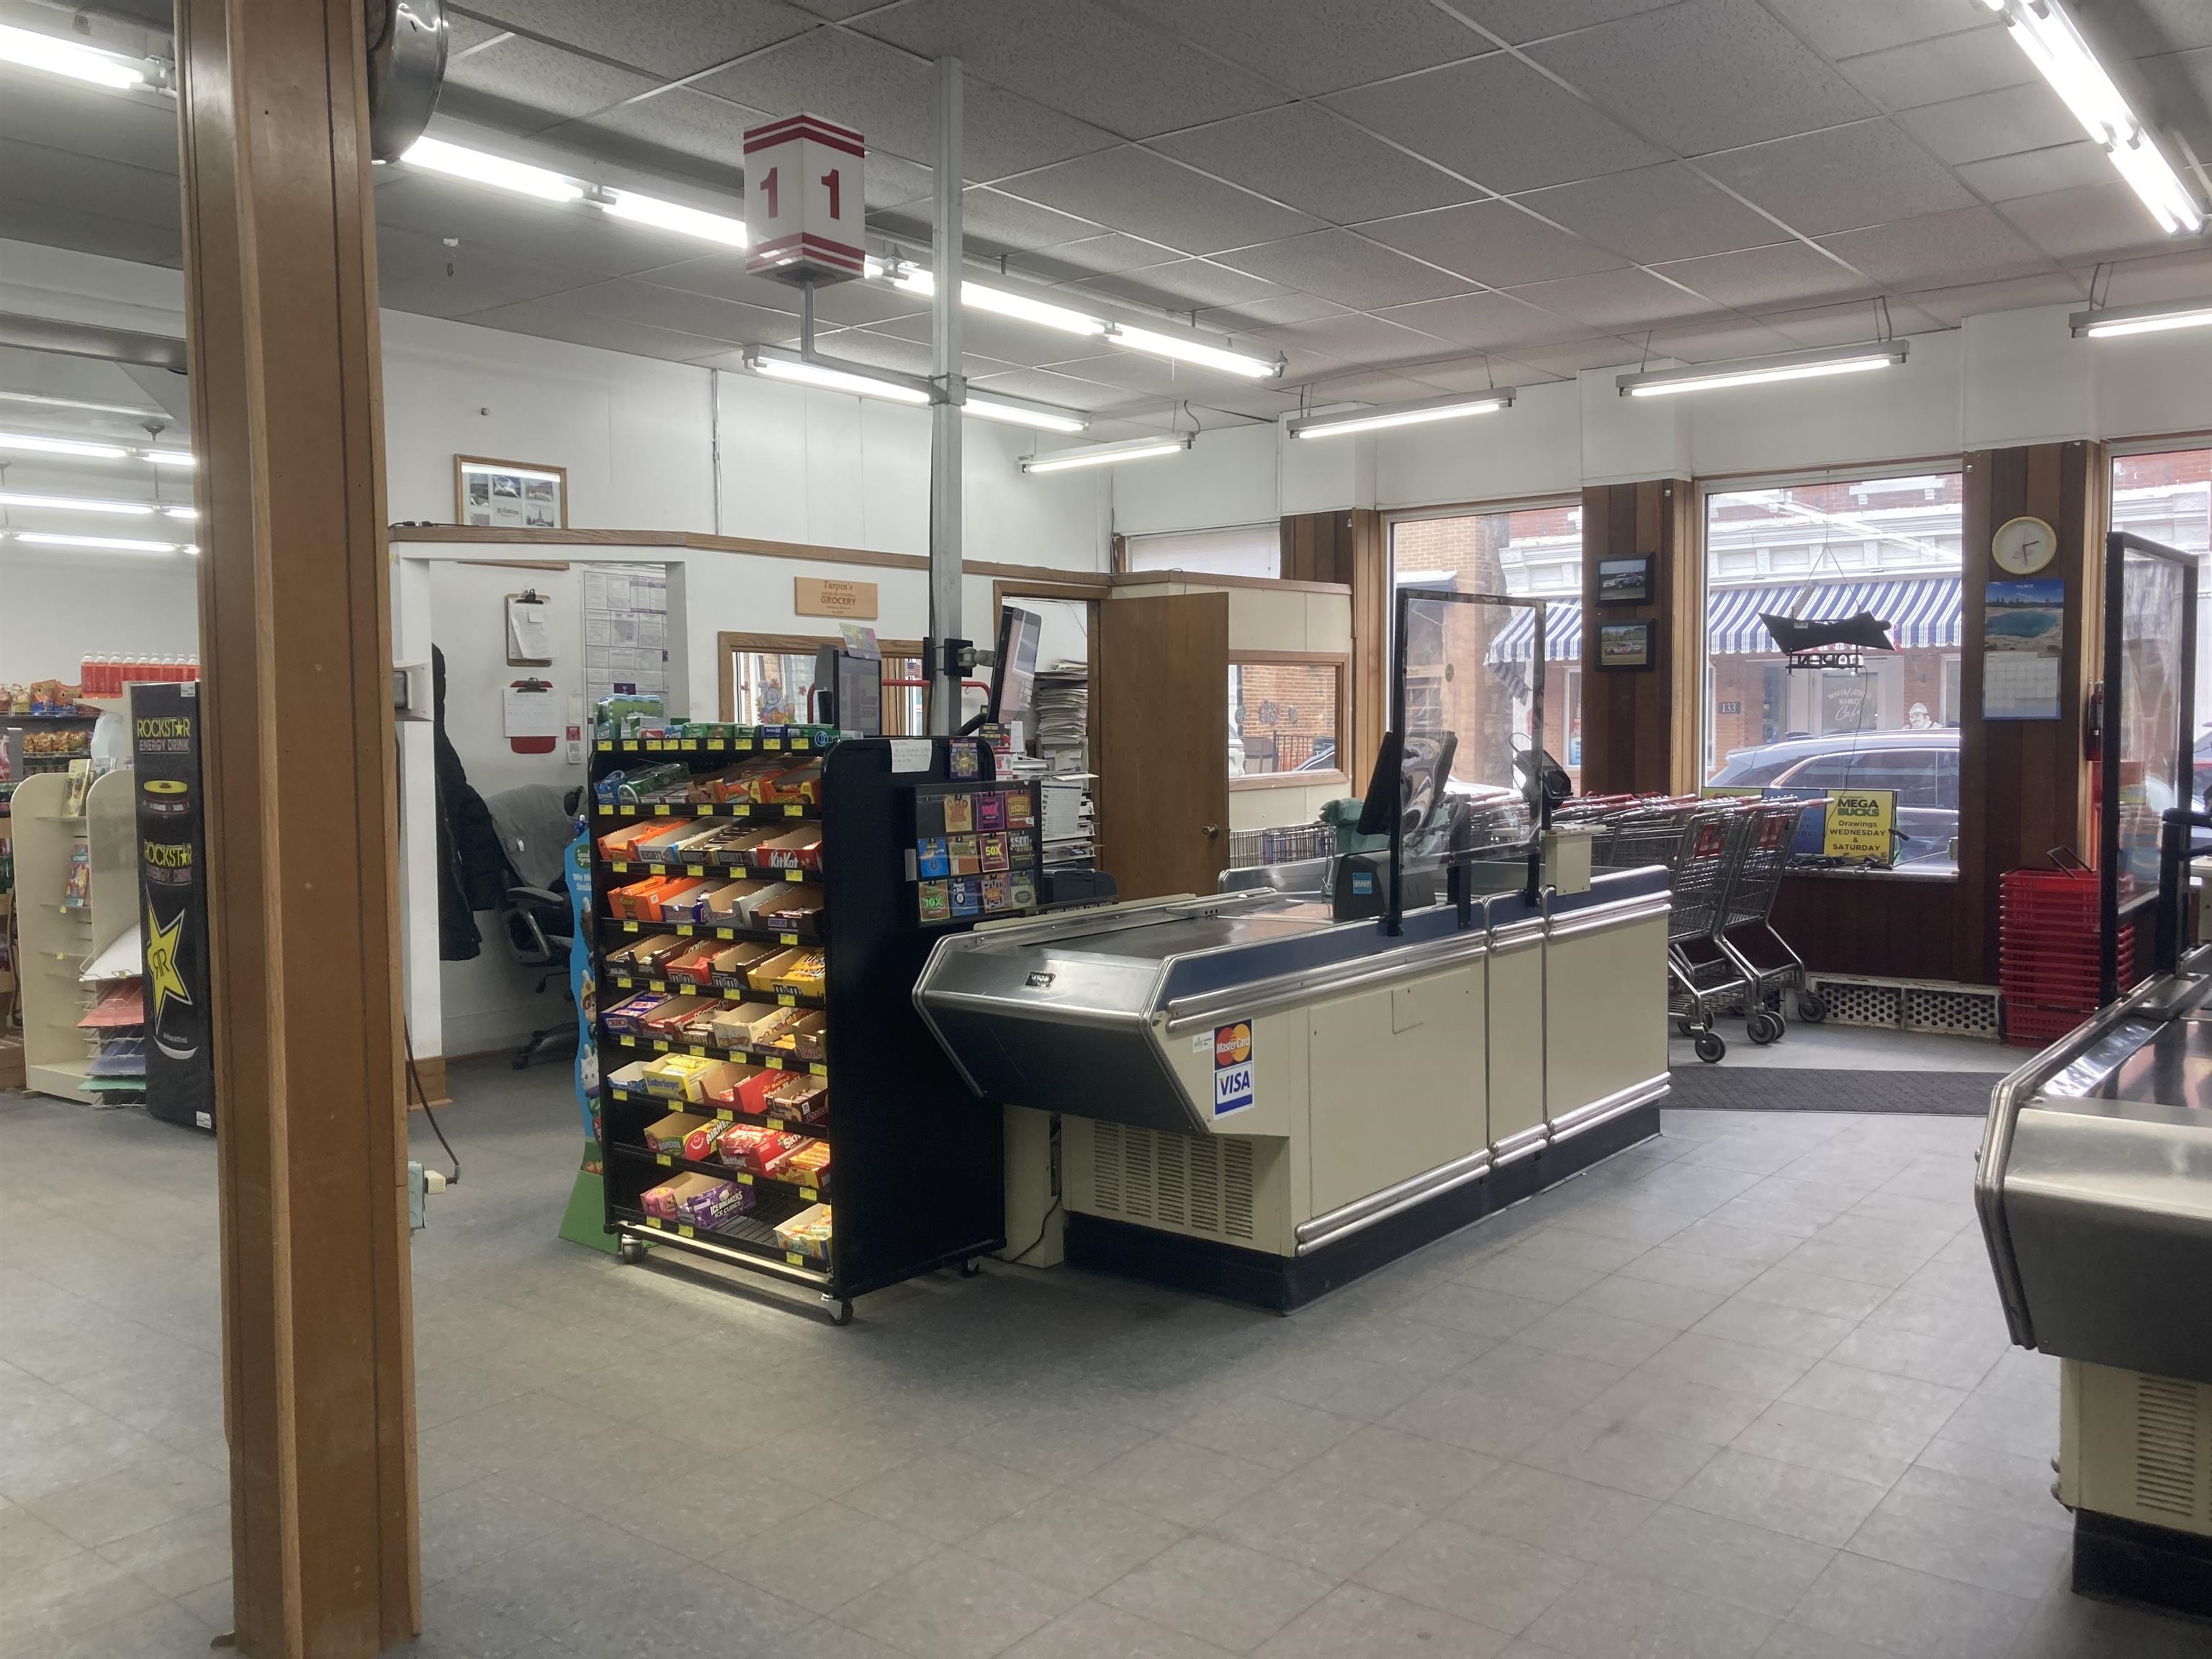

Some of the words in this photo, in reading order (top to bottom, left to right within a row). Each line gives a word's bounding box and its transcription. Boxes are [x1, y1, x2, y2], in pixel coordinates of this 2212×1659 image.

[760, 166, 778, 219] 1
[821, 168, 840, 220] 1
[824, 580, 853, 591] Turpin's
[821, 596, 856, 605] GROCERY
[1722, 703, 1736, 713] 133
[814, 729, 839, 747] Orbit
[140, 739, 166, 751] ENERGY
[1838, 799, 1879, 808] MEGA
[1838, 807, 1879, 817] BUCKS
[985, 844, 1002, 856] 50X
[1833, 843, 1881, 852] SATURDAY
[924, 894, 945, 909] 10X
[1216, 1037, 1250, 1054] MasterCard
[1218, 1070, 1250, 1096] VISA
[719, 1190, 743, 1211] BREAKERS
[724, 1201, 741, 1215] CUBES
